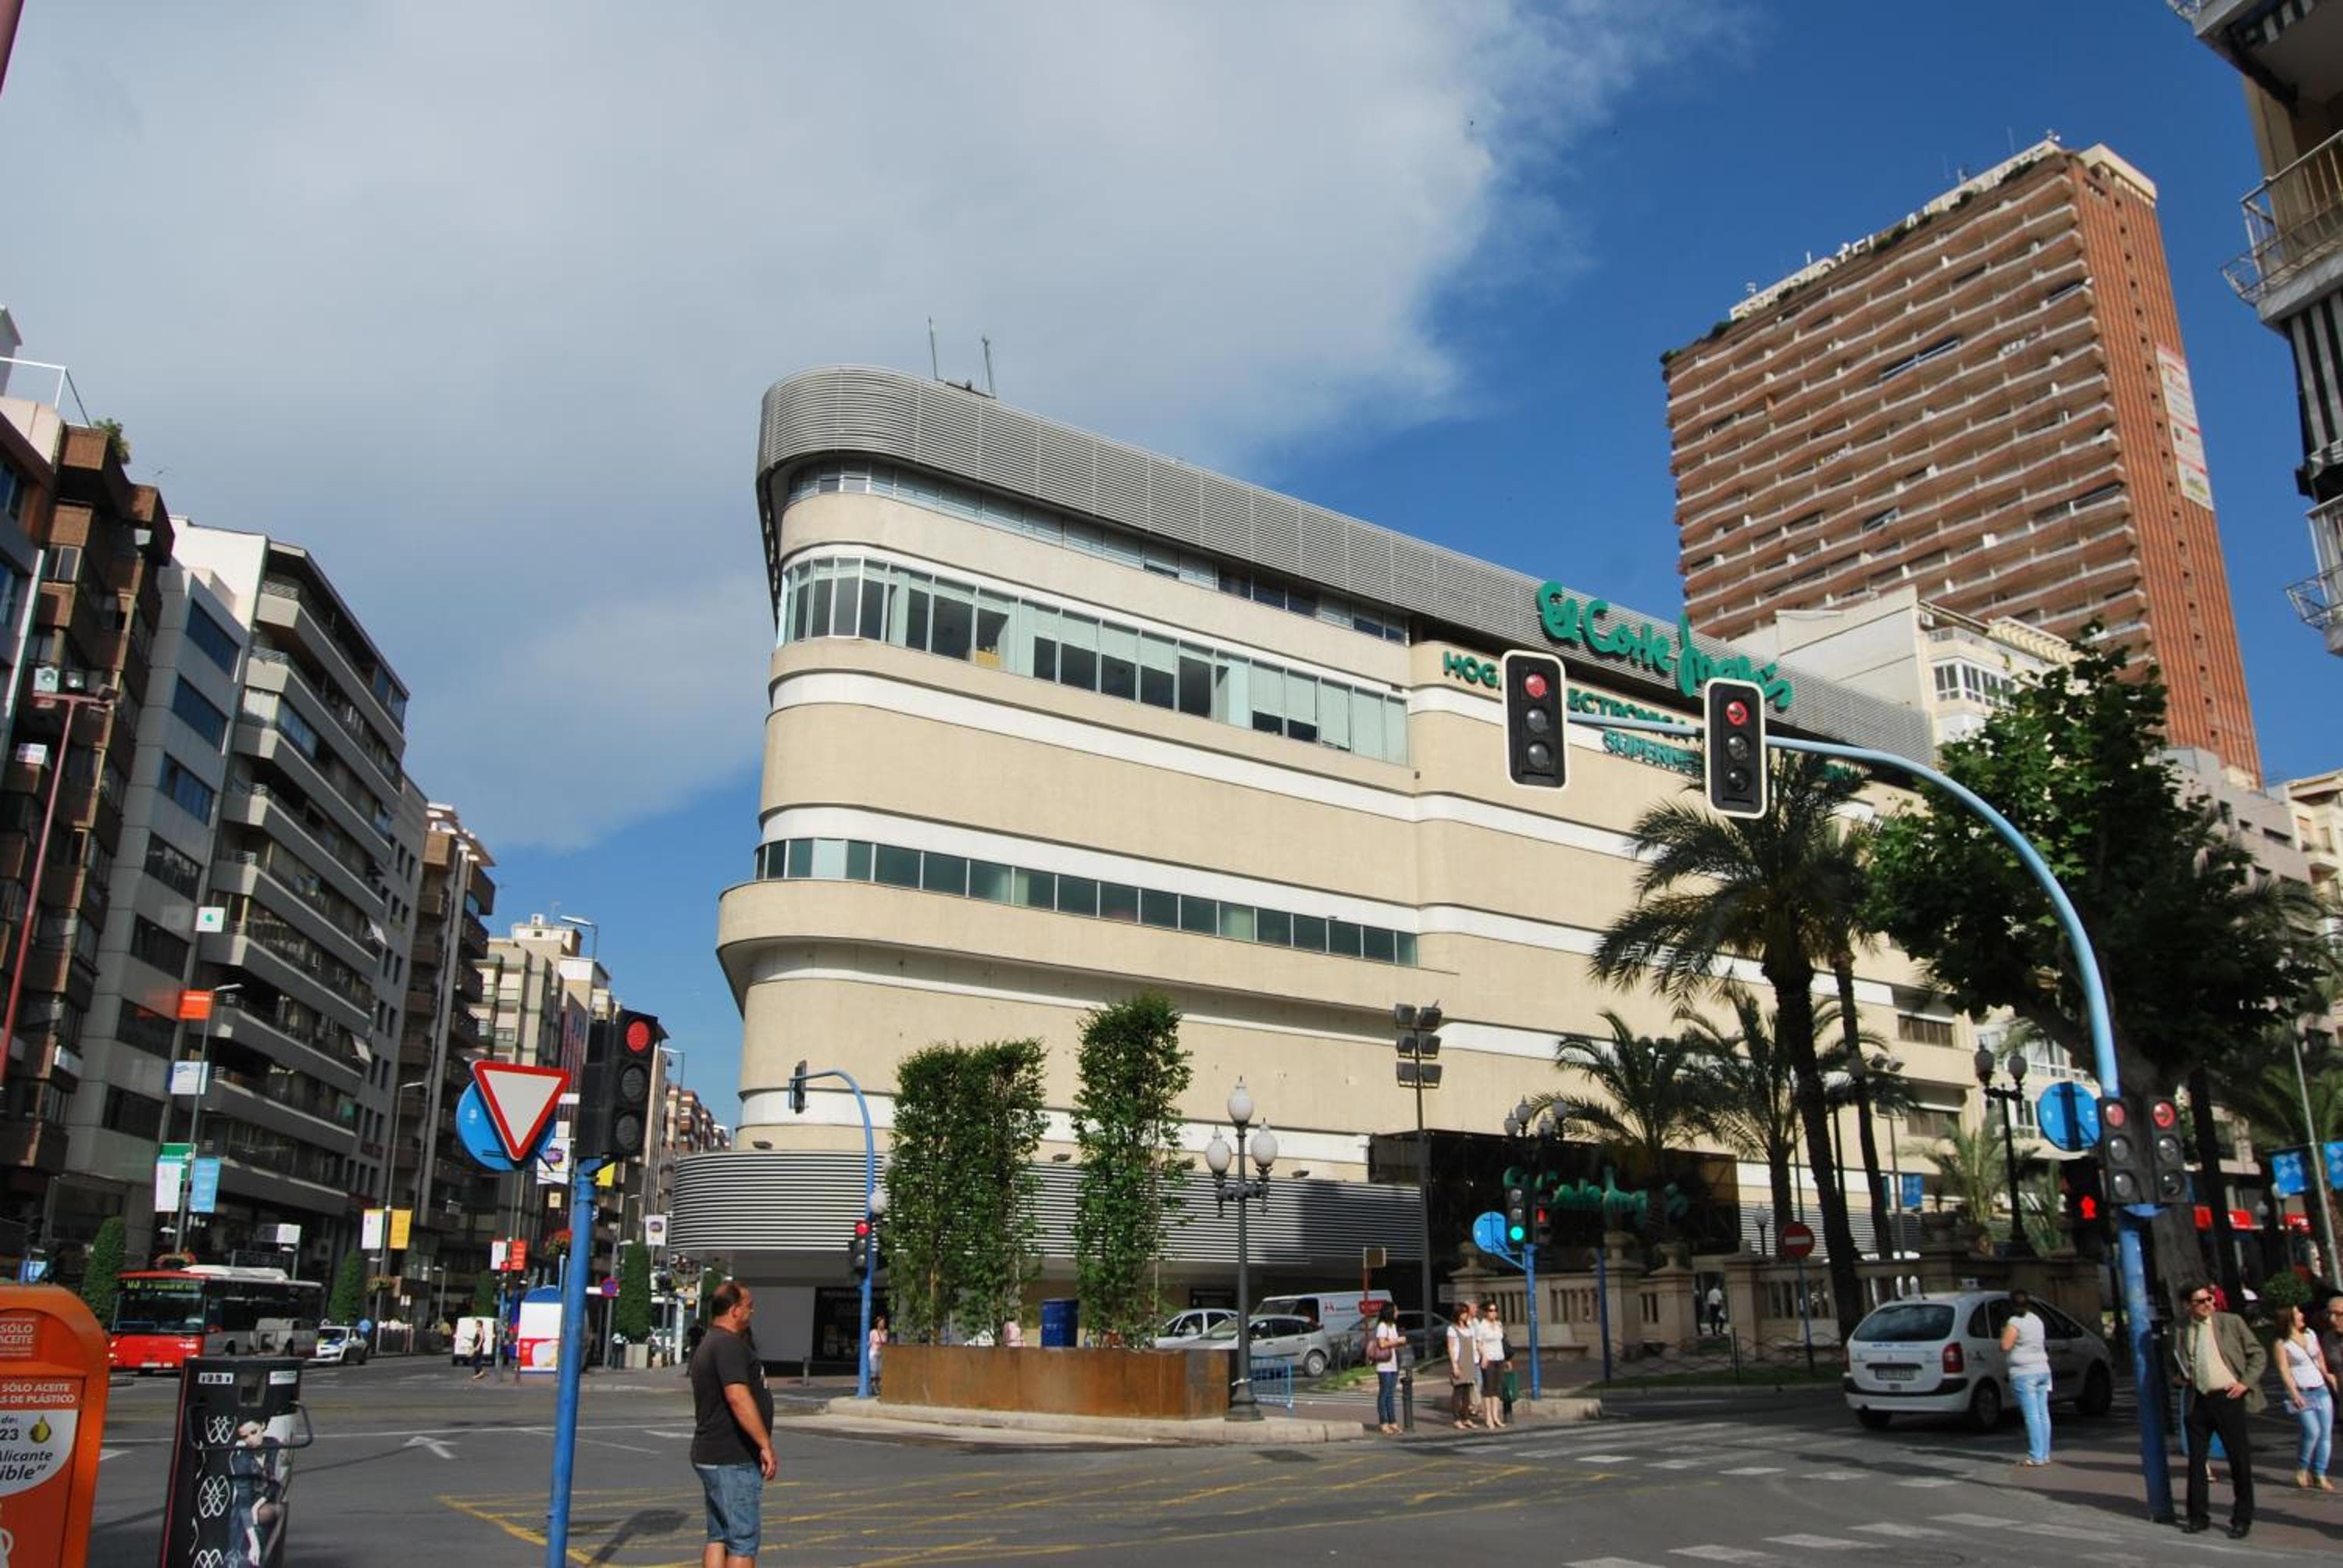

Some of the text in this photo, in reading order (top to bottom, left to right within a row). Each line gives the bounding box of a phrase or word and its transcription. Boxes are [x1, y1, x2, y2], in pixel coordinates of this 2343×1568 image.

[1537, 580, 1583, 642] El
[1580, 599, 1674, 672] Corte
[1443, 650, 1498, 686] HOG
